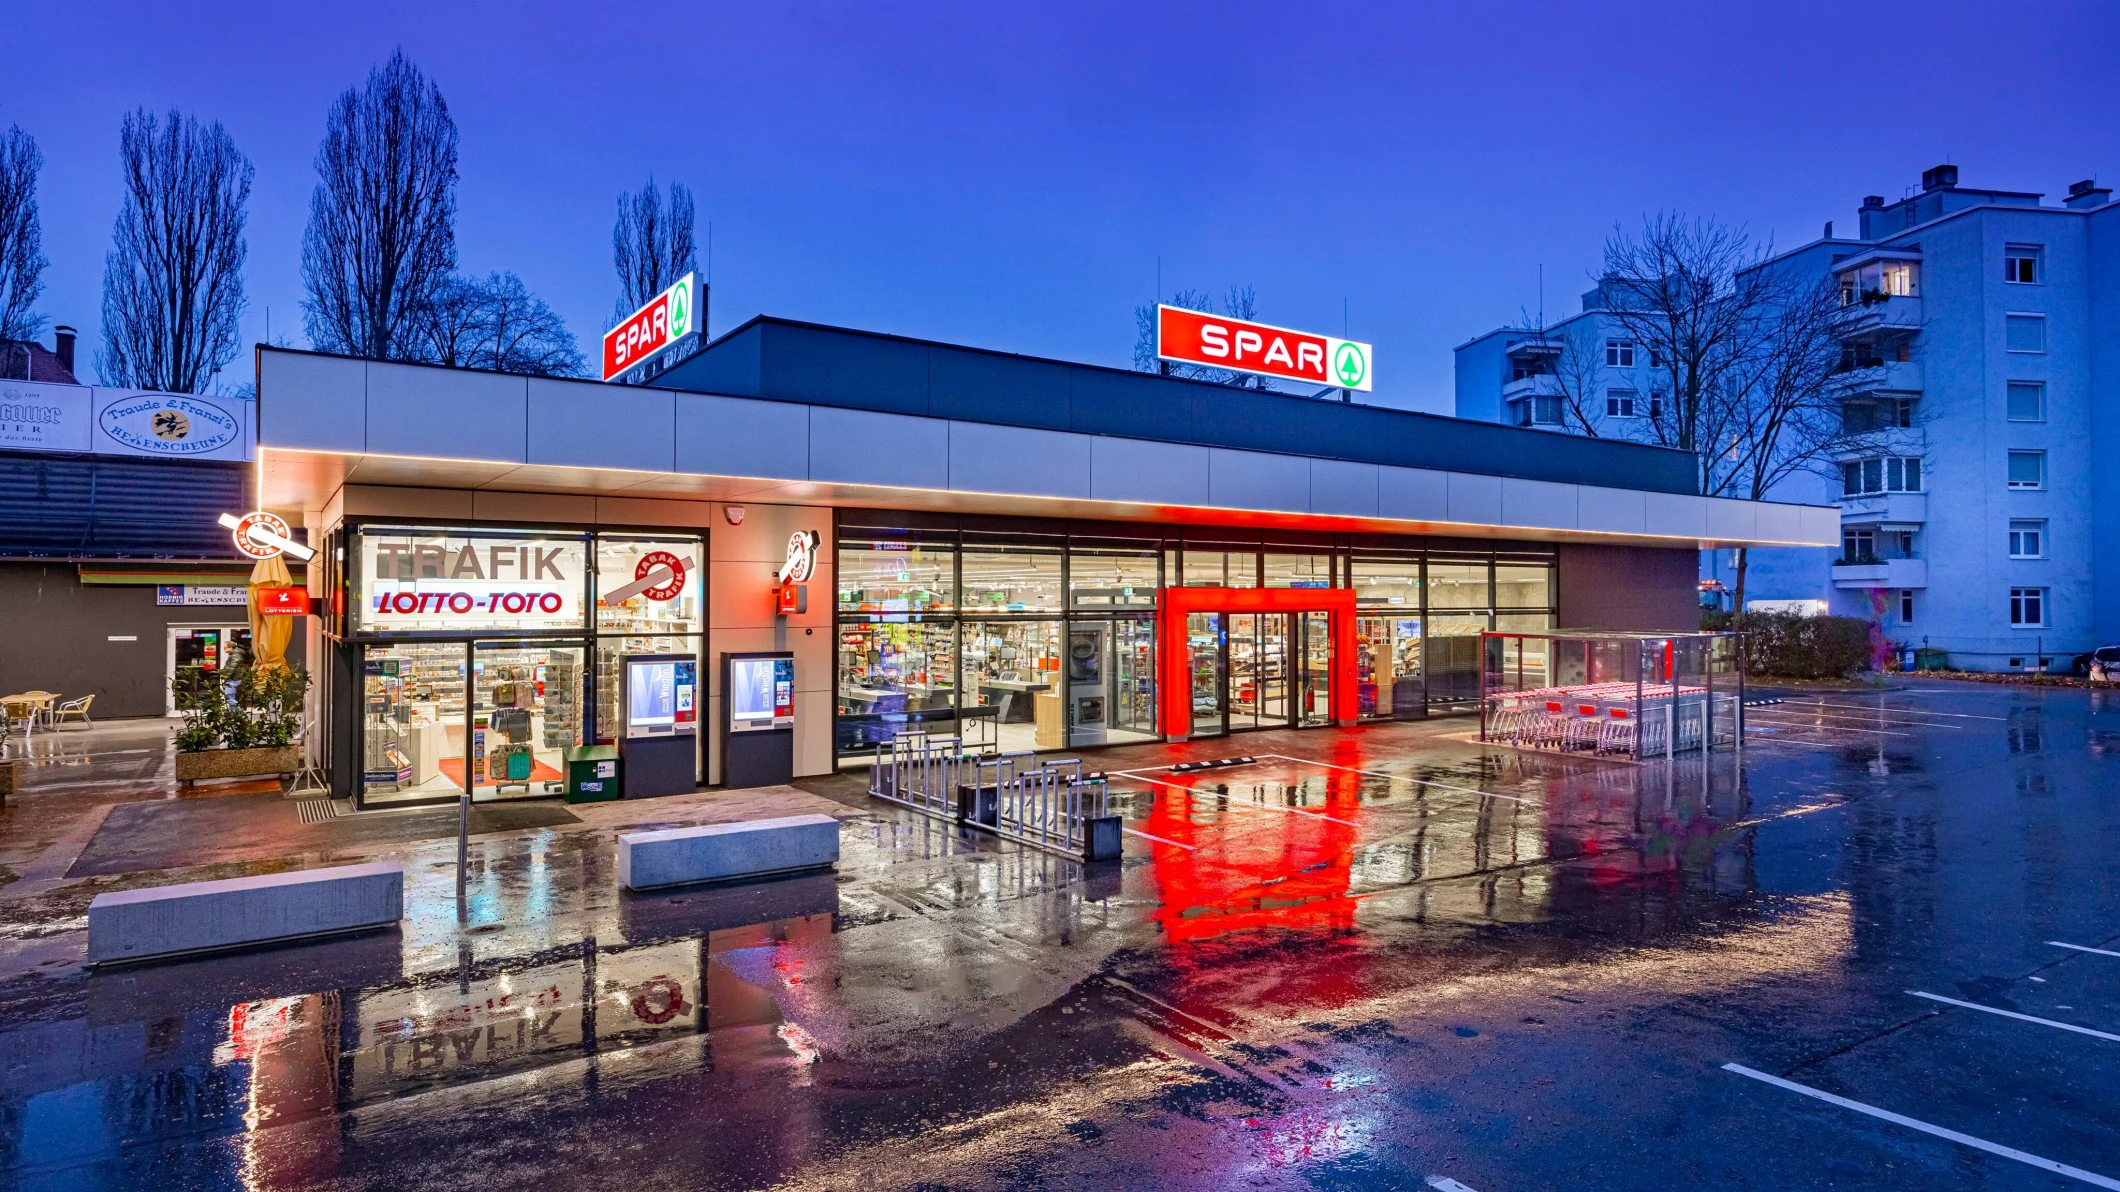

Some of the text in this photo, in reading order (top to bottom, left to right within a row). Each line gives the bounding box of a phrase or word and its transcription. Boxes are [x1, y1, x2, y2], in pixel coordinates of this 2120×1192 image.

[615, 304, 666, 366] SPAR
[1200, 323, 1324, 375] SPAR
[0, 403, 62, 425] rauer
[107, 400, 161, 420] Traude
[166, 399, 179, 409] &
[1, 424, 42, 434] IER
[246, 515, 286, 534] TABAK
[238, 531, 275, 556] TRAFIK
[377, 543, 566, 581] TRAFIK
[638, 553, 677, 576] TABAK
[192, 587, 221, 595] Traude
[648, 572, 684, 599] TRAFIK
[378, 591, 563, 615] LOTTO-TOTO
[659, 668, 670, 699] Winston
